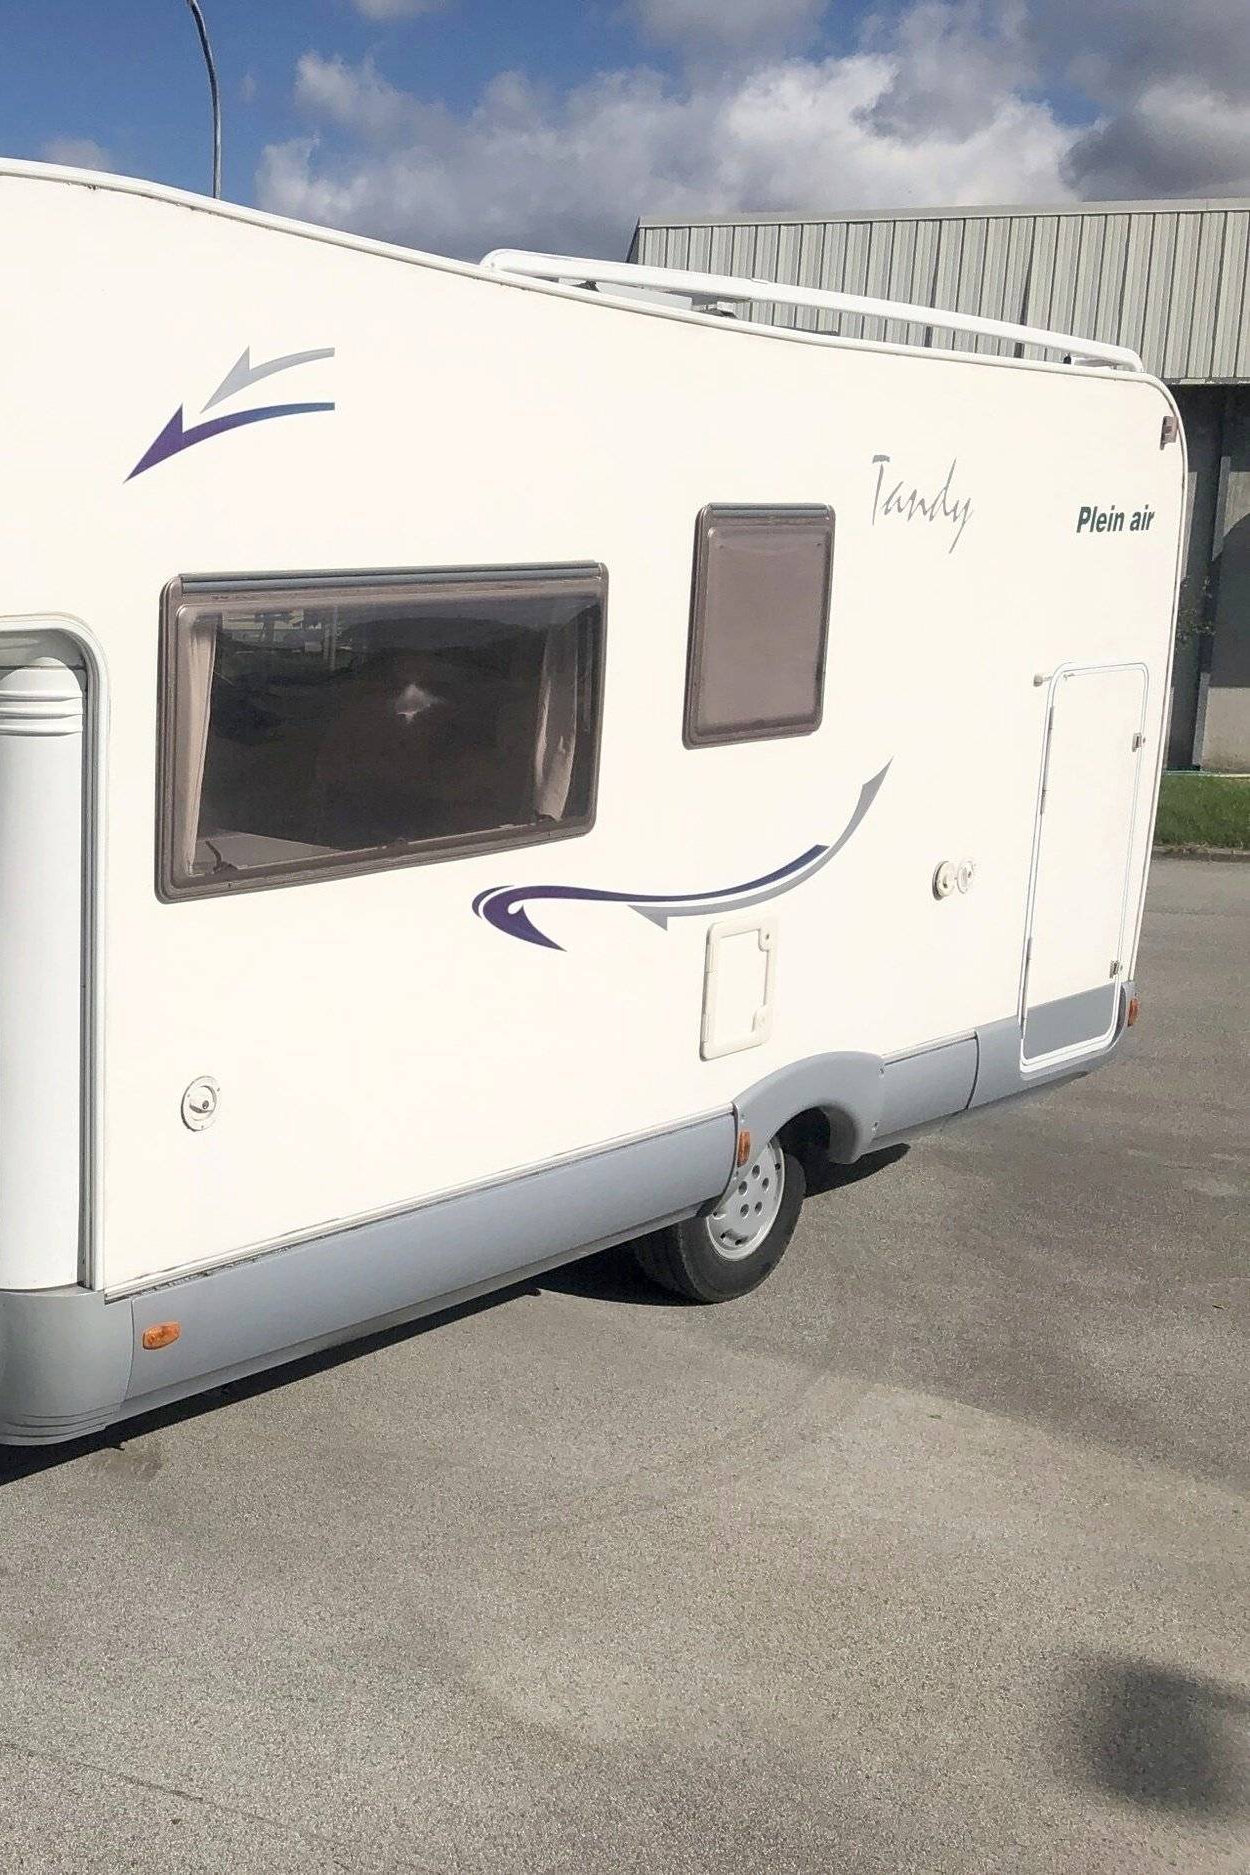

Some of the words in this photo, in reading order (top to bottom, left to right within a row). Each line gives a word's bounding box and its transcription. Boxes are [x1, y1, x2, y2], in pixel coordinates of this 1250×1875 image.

[872, 454, 974, 554] Tandy
[1076, 505, 1125, 533] Plein
[1129, 503, 1155, 531] air
